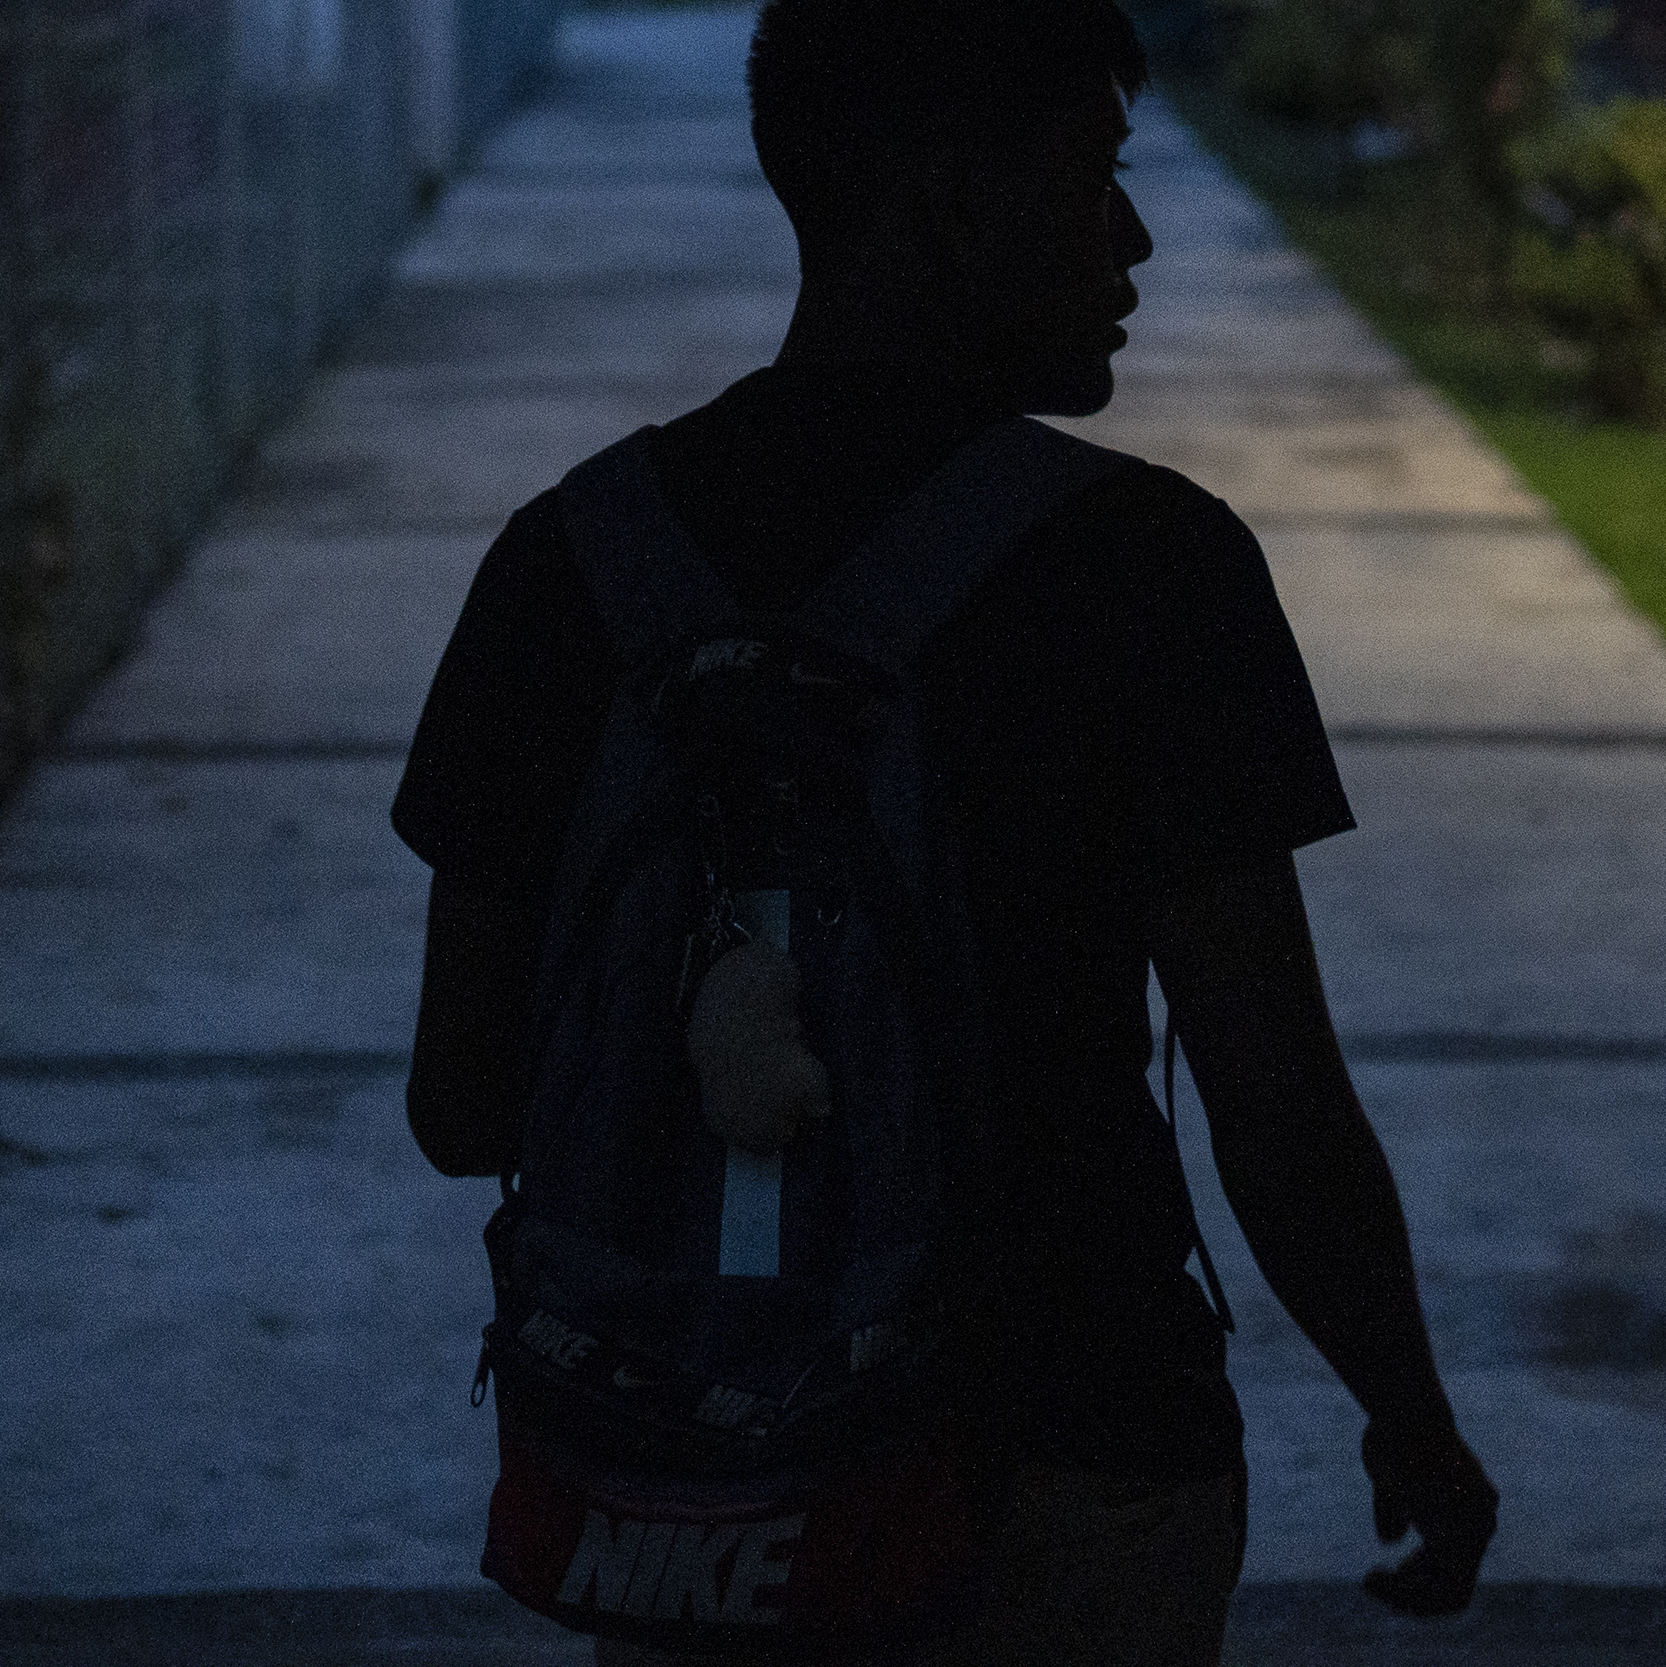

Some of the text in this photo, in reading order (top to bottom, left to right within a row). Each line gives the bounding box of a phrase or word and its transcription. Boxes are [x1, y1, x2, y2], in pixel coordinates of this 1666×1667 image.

[688, 631, 770, 681] NIKE
[517, 1308, 600, 1370] NIKE
[556, 1508, 808, 1626] NIKE
